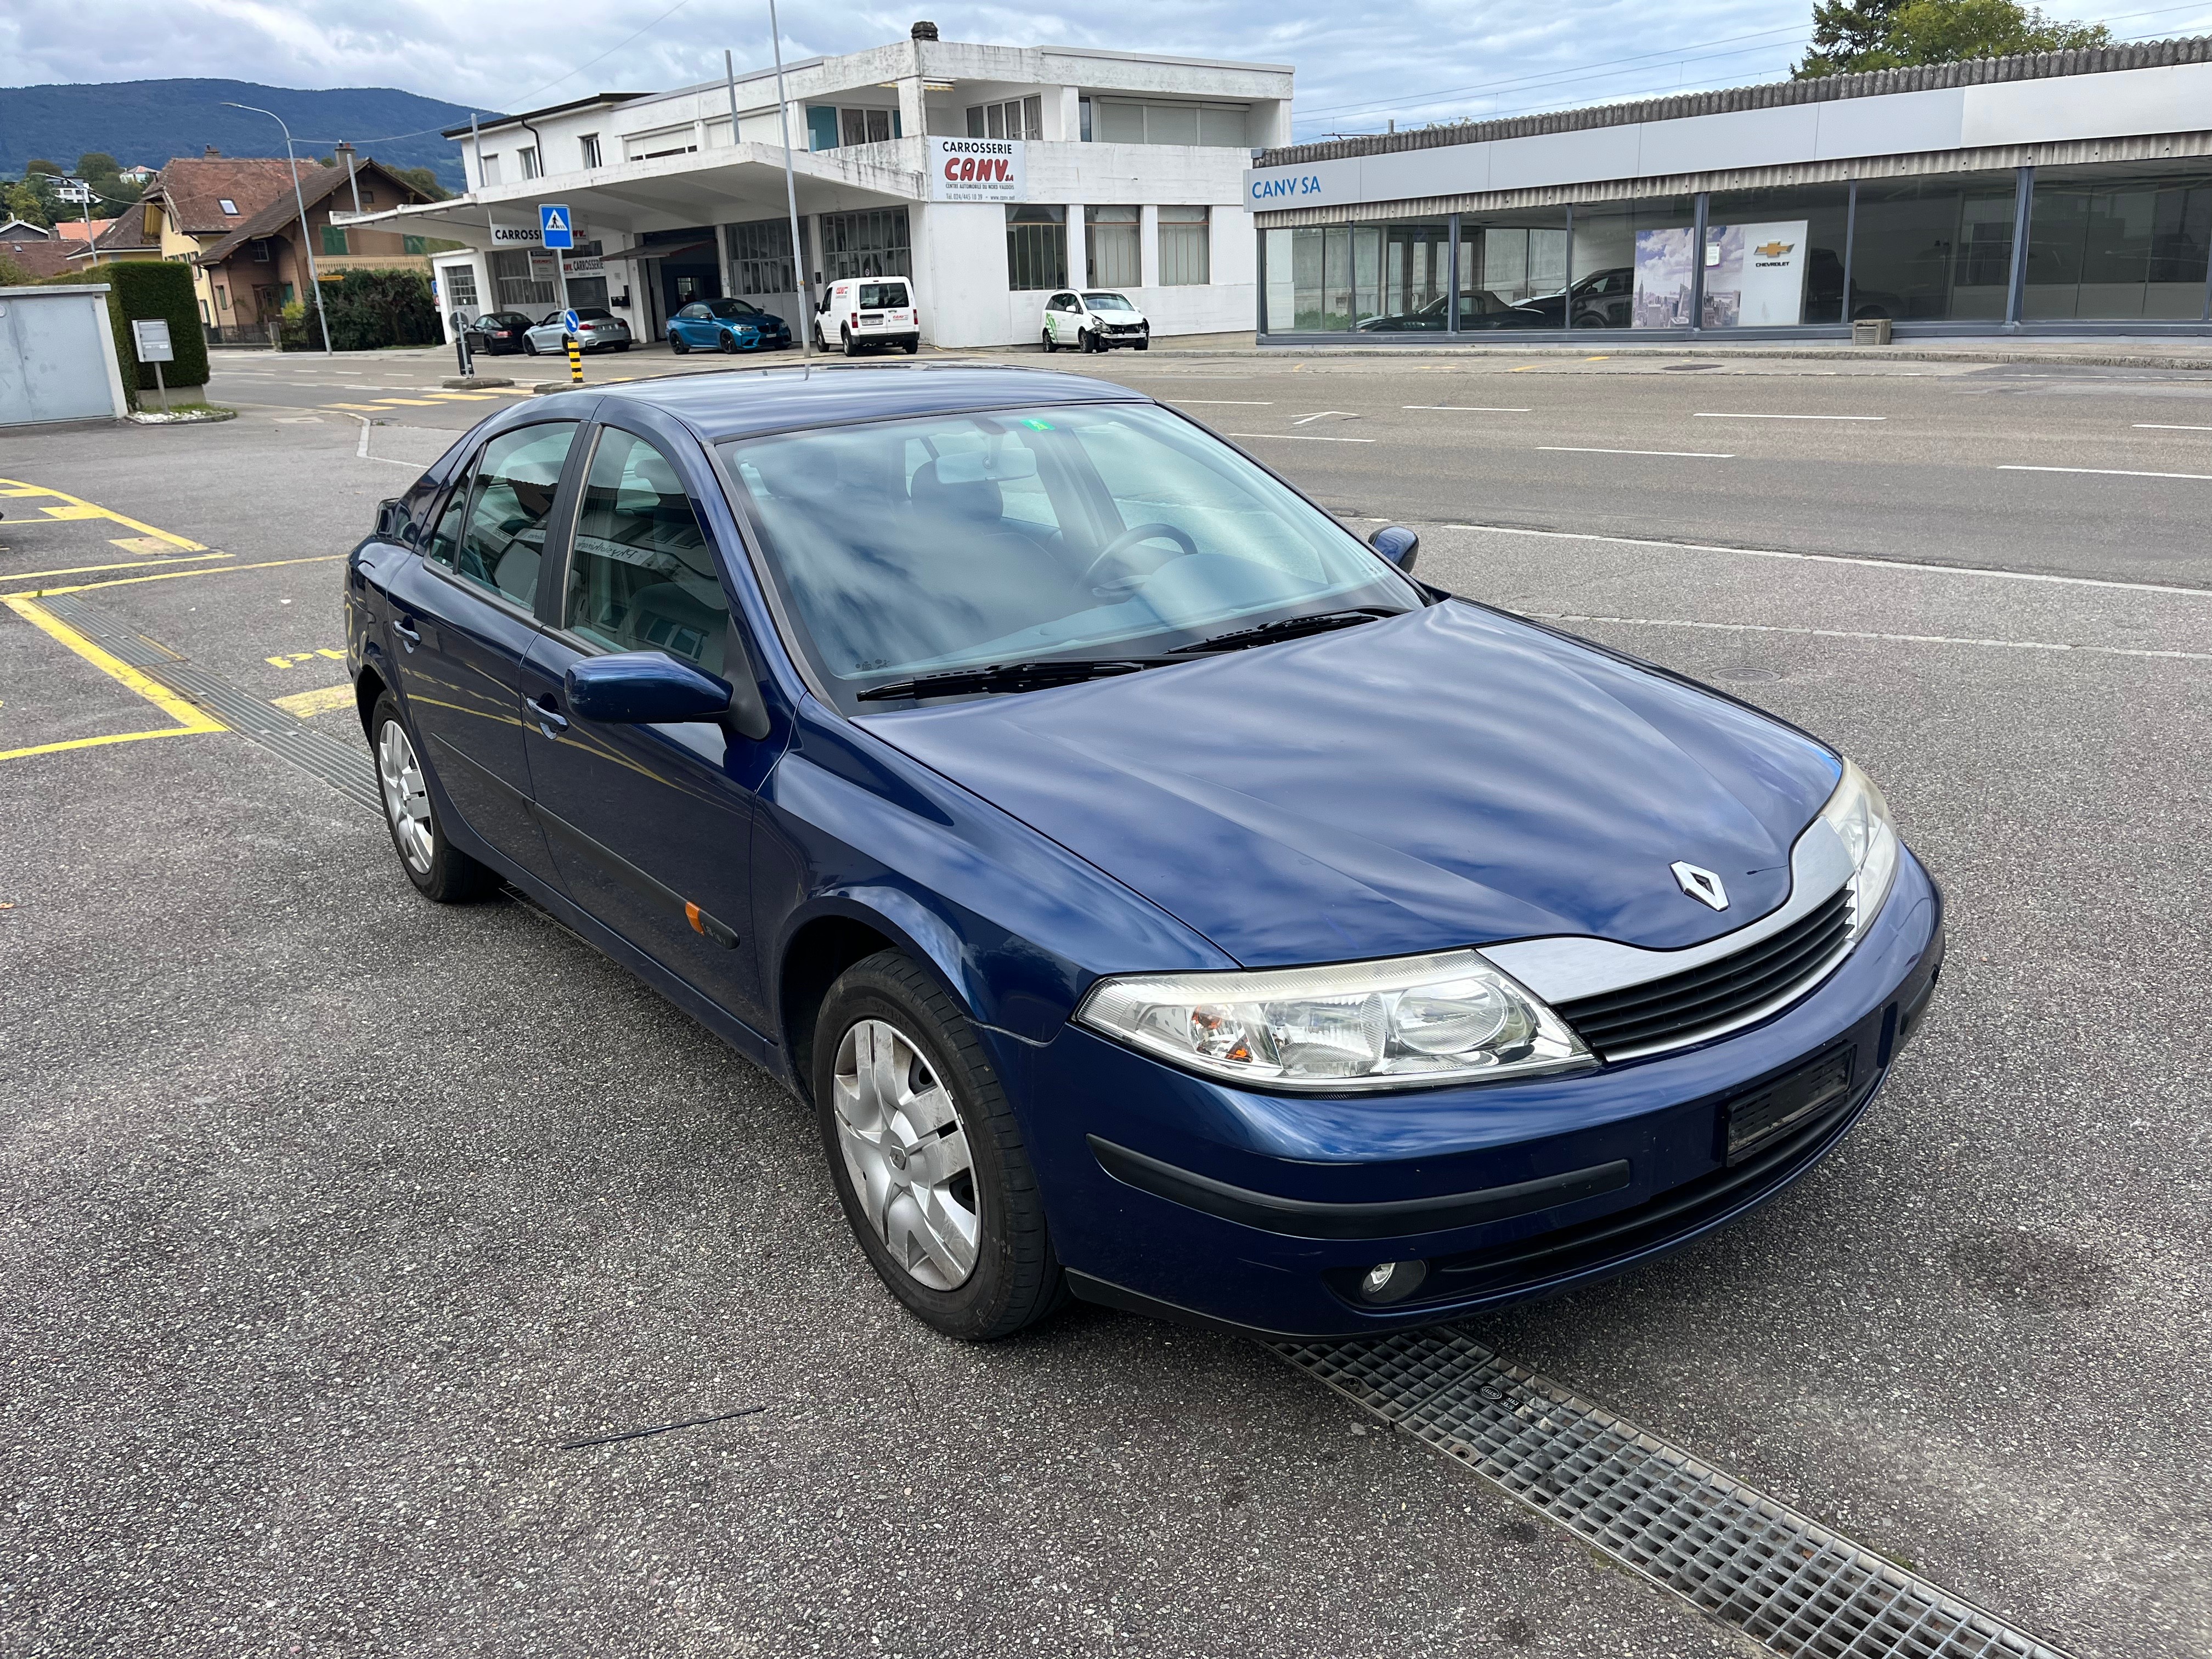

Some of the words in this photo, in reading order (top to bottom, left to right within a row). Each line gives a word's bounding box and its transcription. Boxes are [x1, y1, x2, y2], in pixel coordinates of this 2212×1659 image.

[943, 141, 1012, 154] CARROSSERIE
[945, 157, 1008, 182] CANV
[1252, 178, 1297, 199] CANV
[1302, 176, 1322, 194] SA
